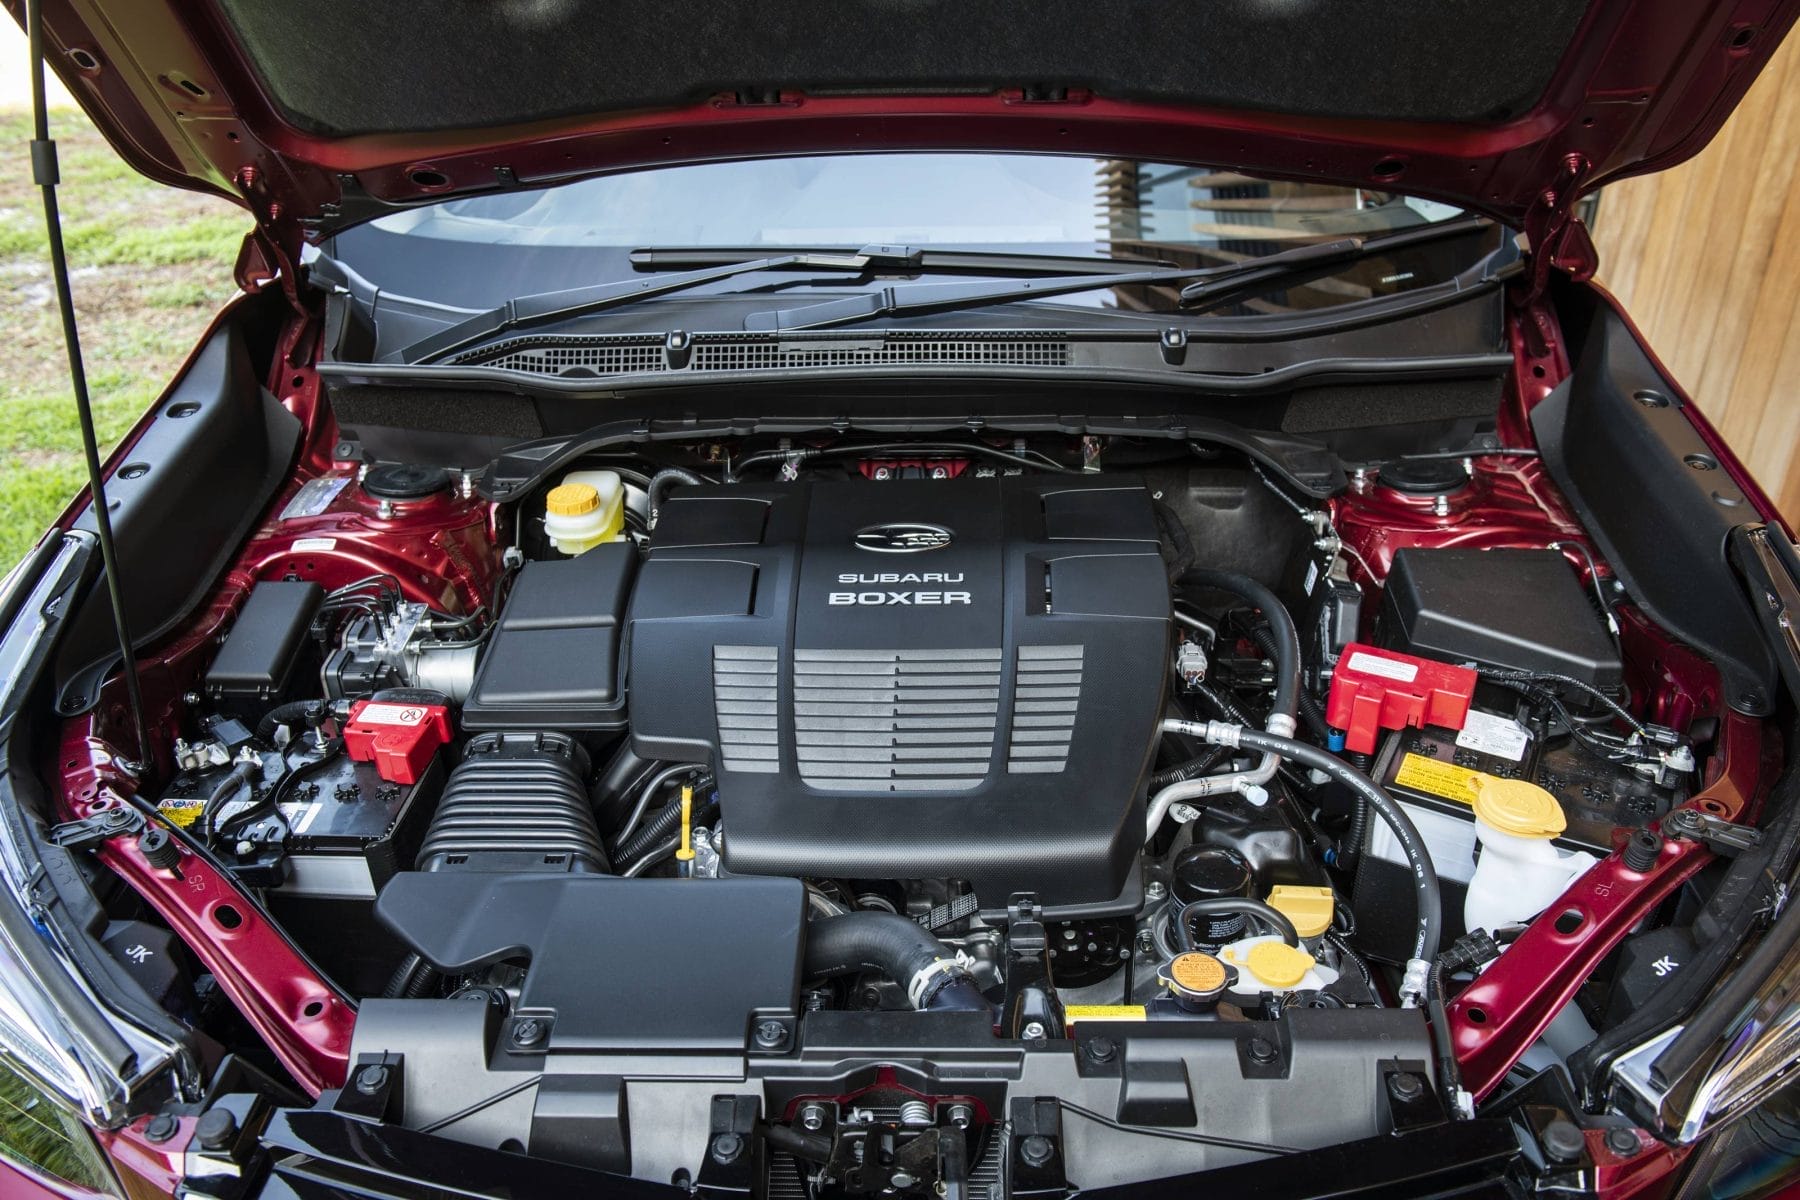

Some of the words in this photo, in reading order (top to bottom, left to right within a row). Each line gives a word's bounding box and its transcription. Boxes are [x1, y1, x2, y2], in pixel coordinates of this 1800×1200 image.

[838, 572, 964, 584] SUBARU
[828, 591, 972, 606] BOXER
[188, 874, 206, 894] SR
[1595, 881, 1615, 897] SL
[125, 944, 154, 963] JK
[1651, 955, 1680, 976] JK
